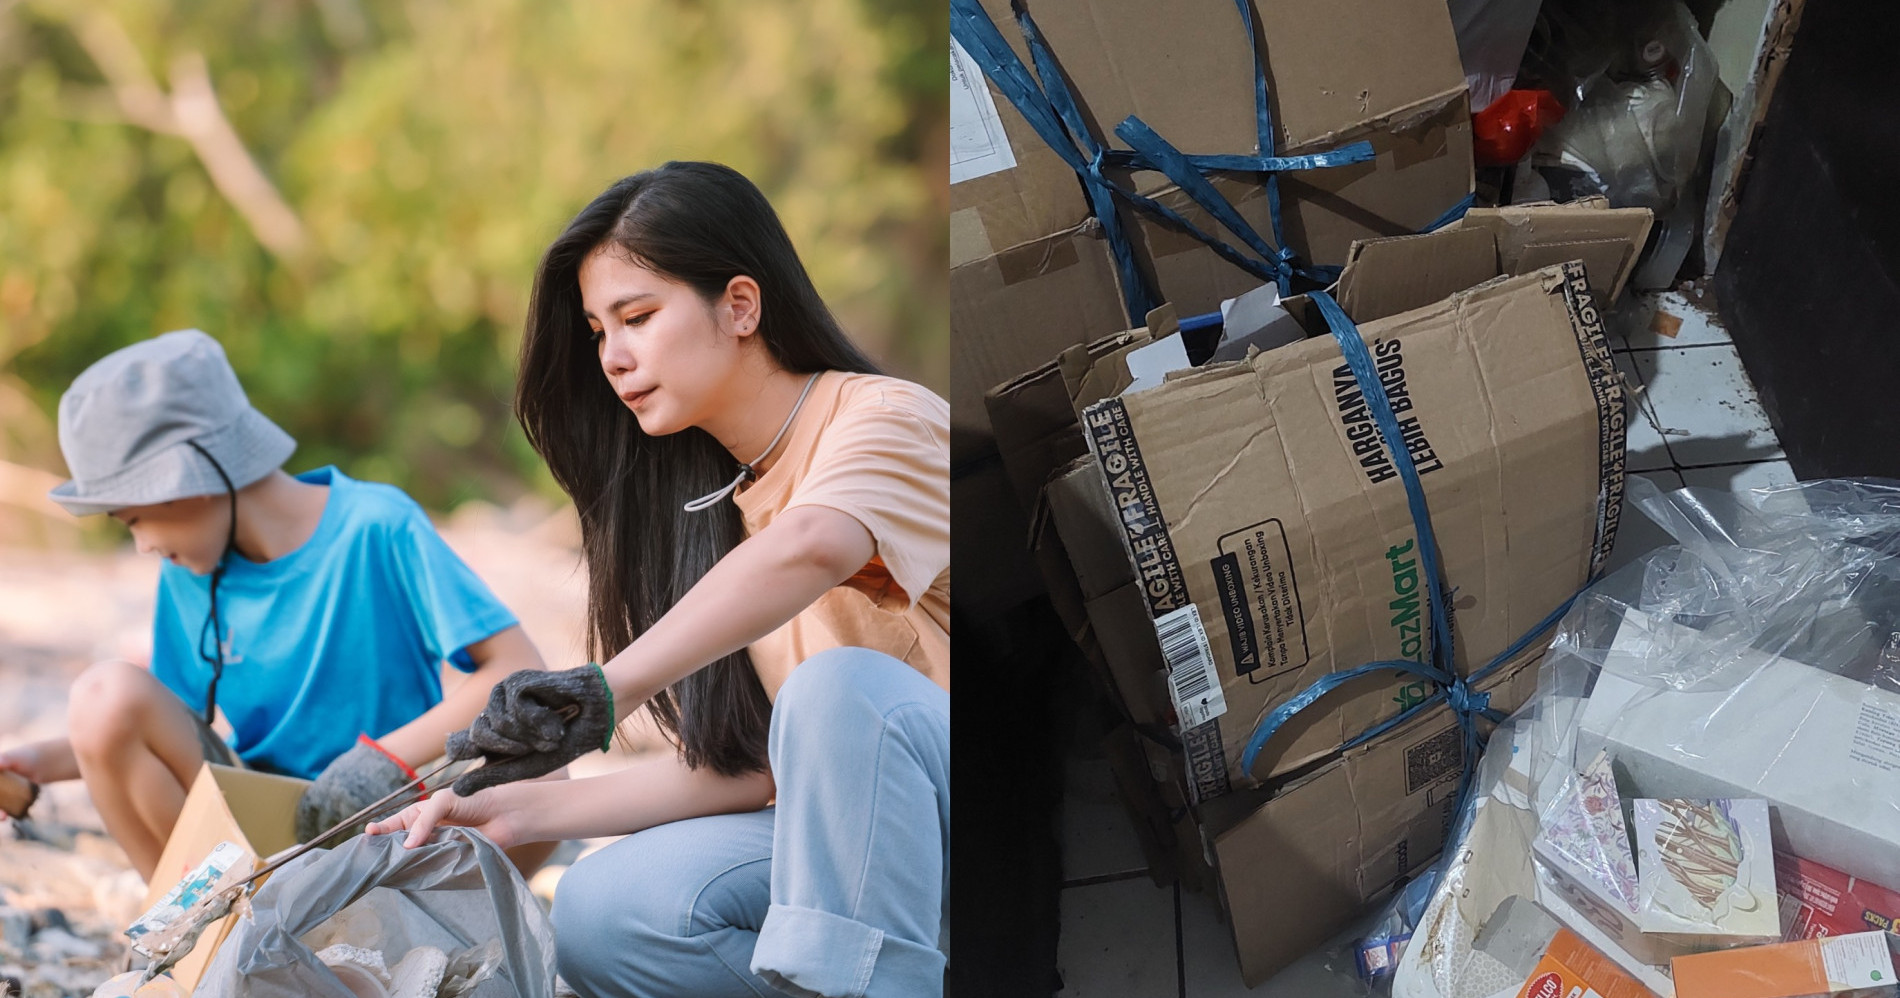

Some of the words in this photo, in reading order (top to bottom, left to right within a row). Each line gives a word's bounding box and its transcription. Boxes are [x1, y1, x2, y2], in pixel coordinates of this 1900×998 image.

[1568, 262, 1609, 359] FRAGILE
[1111, 406, 1129, 436] CARE
[1333, 363, 1397, 484] HARGANYA
[1601, 375, 1624, 461] FRAGILE
[1089, 409, 1145, 521] FRAGILE
[1122, 438, 1141, 470] WITH
[1399, 416, 1443, 475] LEBIH
[1134, 470, 1157, 515] HANDLE
[1603, 472, 1624, 543] FRAGILE
[1155, 531, 1172, 560] CARE
[1245, 538, 1260, 590] Kekurangan
[1256, 531, 1271, 574] Unboxing
[1134, 536, 1176, 610] AGILE
[1166, 562, 1183, 592] WITH
[1222, 563, 1238, 606] UNBOXING
[1266, 570, 1277, 597] Video
[1279, 571, 1290, 607] Diterima
[1232, 606, 1246, 632] VIDEO
[1285, 608, 1294, 627] Tidak
[1238, 630, 1249, 652] WAJIB
[1864, 911, 1890, 928] PACKS
